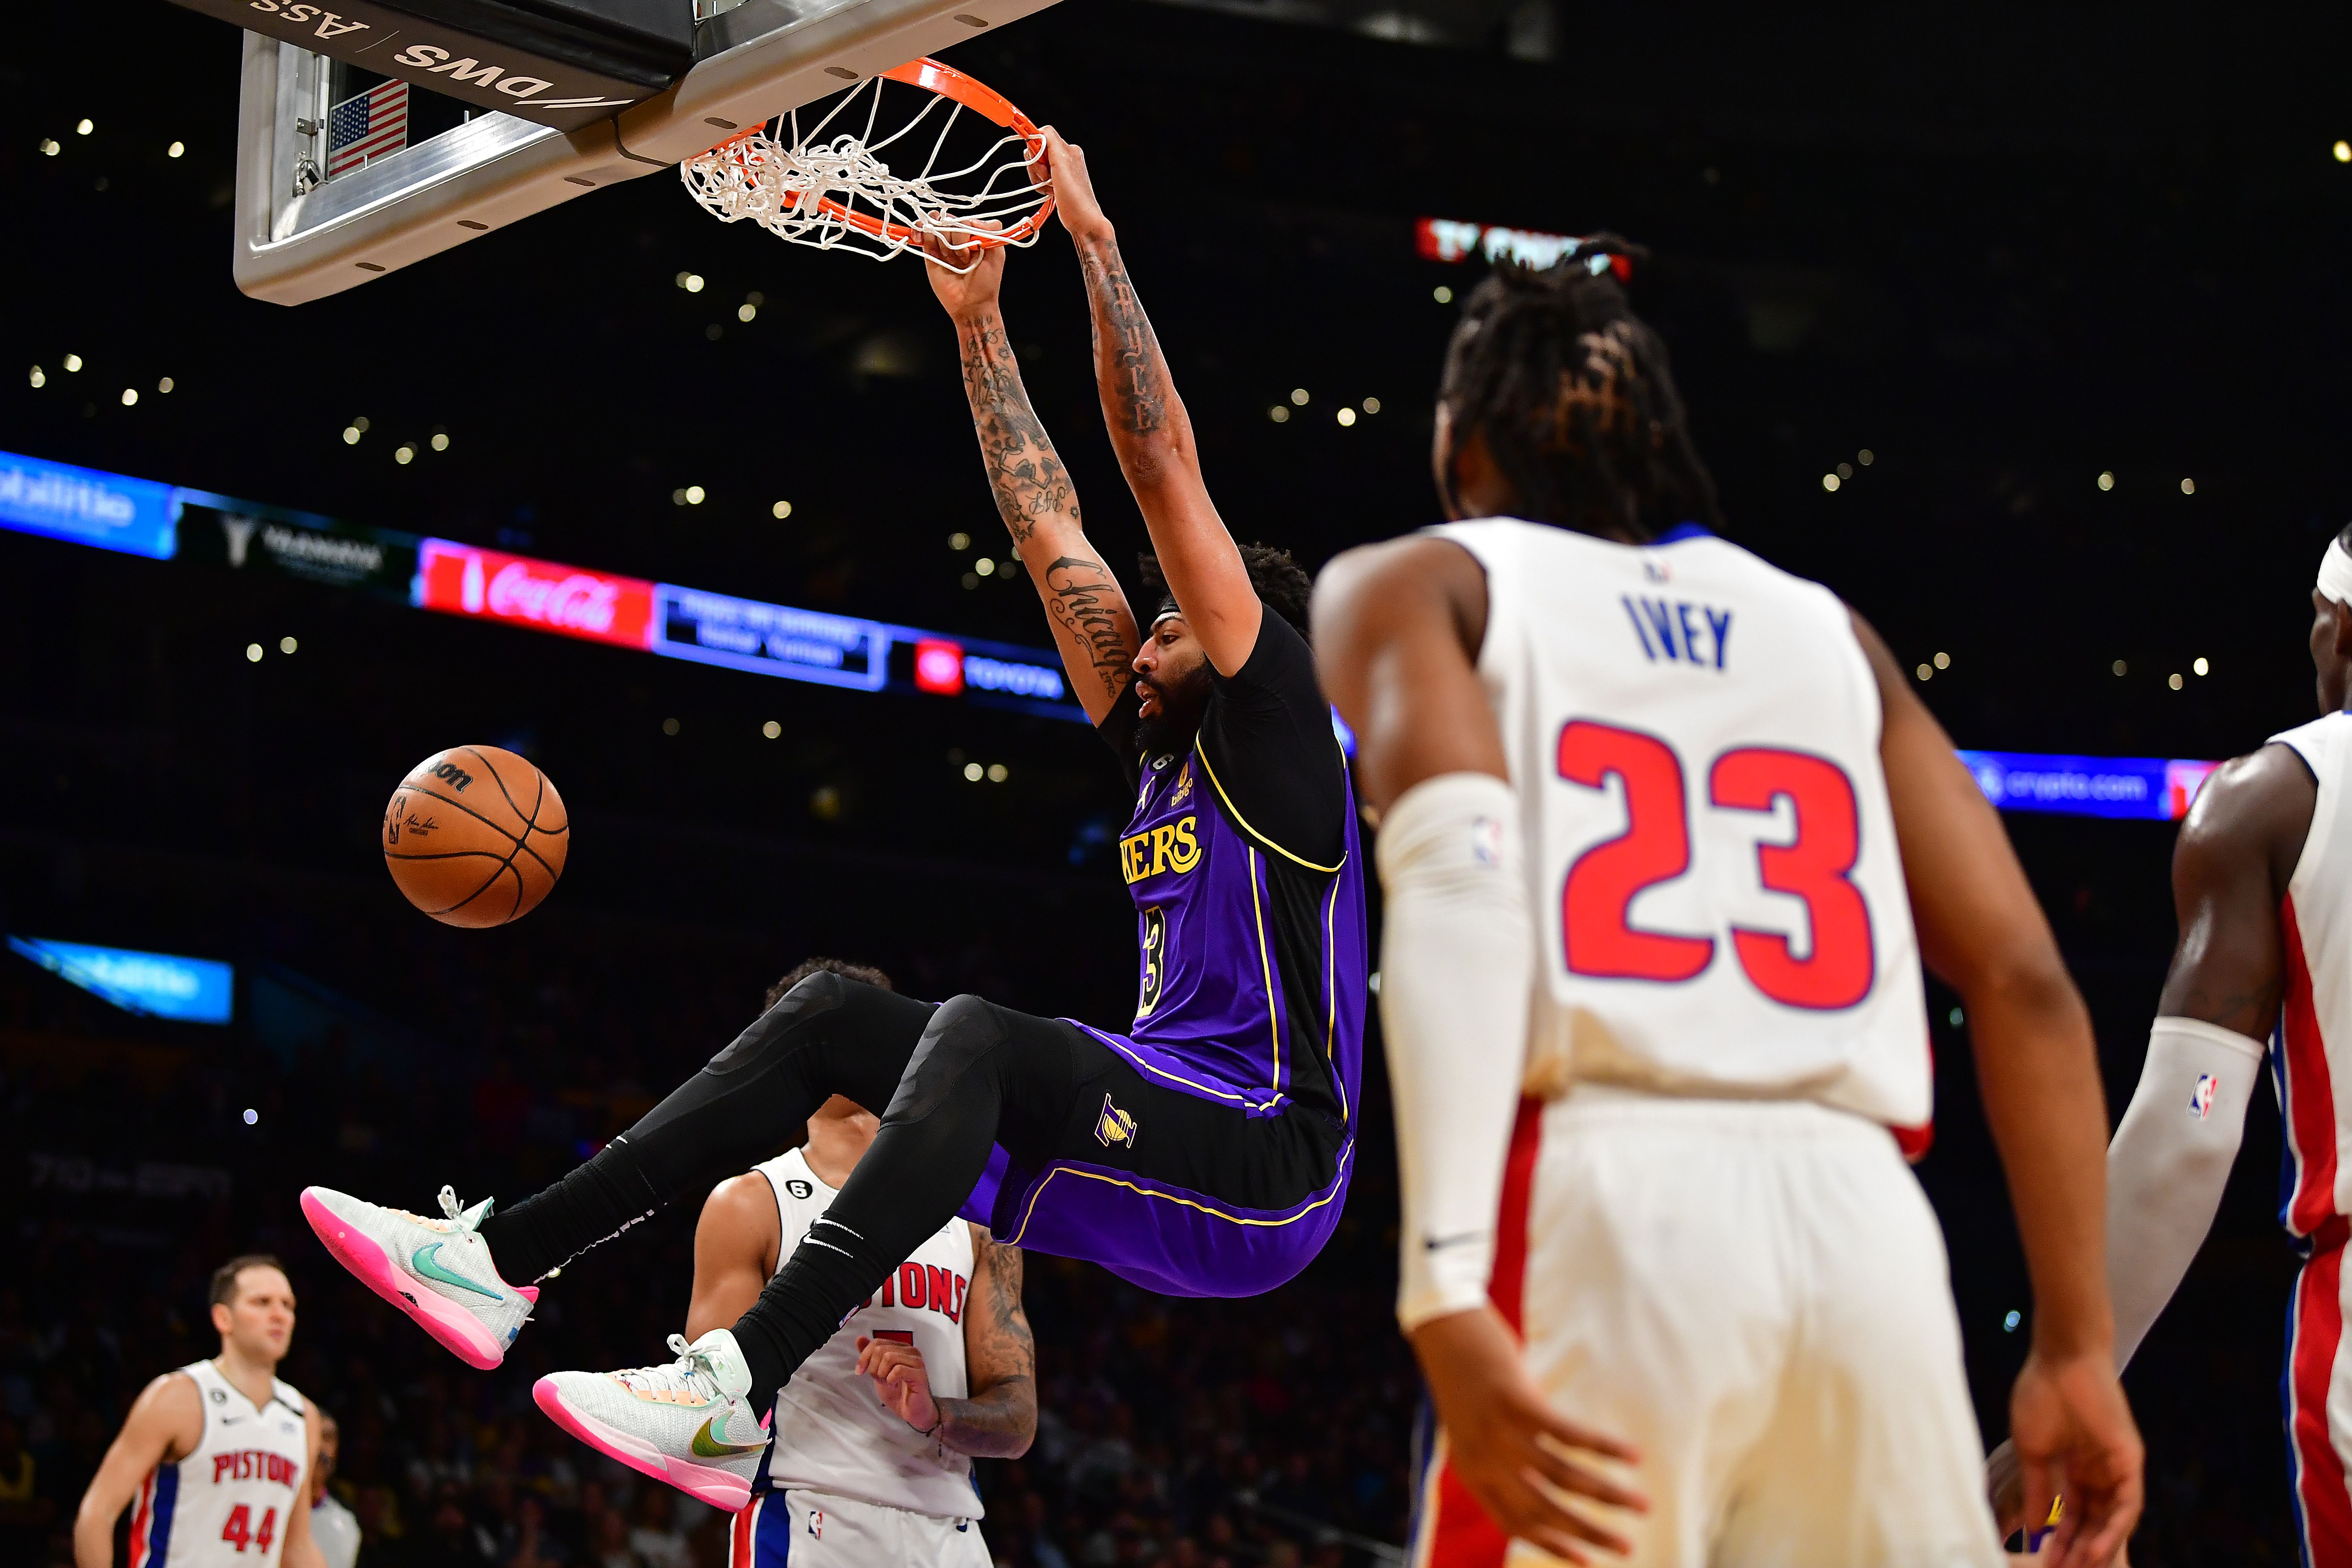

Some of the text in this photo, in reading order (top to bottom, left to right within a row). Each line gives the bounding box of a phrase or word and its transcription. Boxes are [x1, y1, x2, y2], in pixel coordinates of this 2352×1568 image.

[394, 45, 554, 98] DWS
[1046, 556, 1133, 683] Chicago
[1621, 593, 1734, 672] IVEY
[1171, 778, 1193, 807] bibigo
[1555, 717, 1876, 1012] 23
[1136, 905, 1165, 1018] 3
[789, 1181, 808, 1198] 6
[860, 1262, 966, 1325] TONS
[222, 1504, 278, 1554] 44
